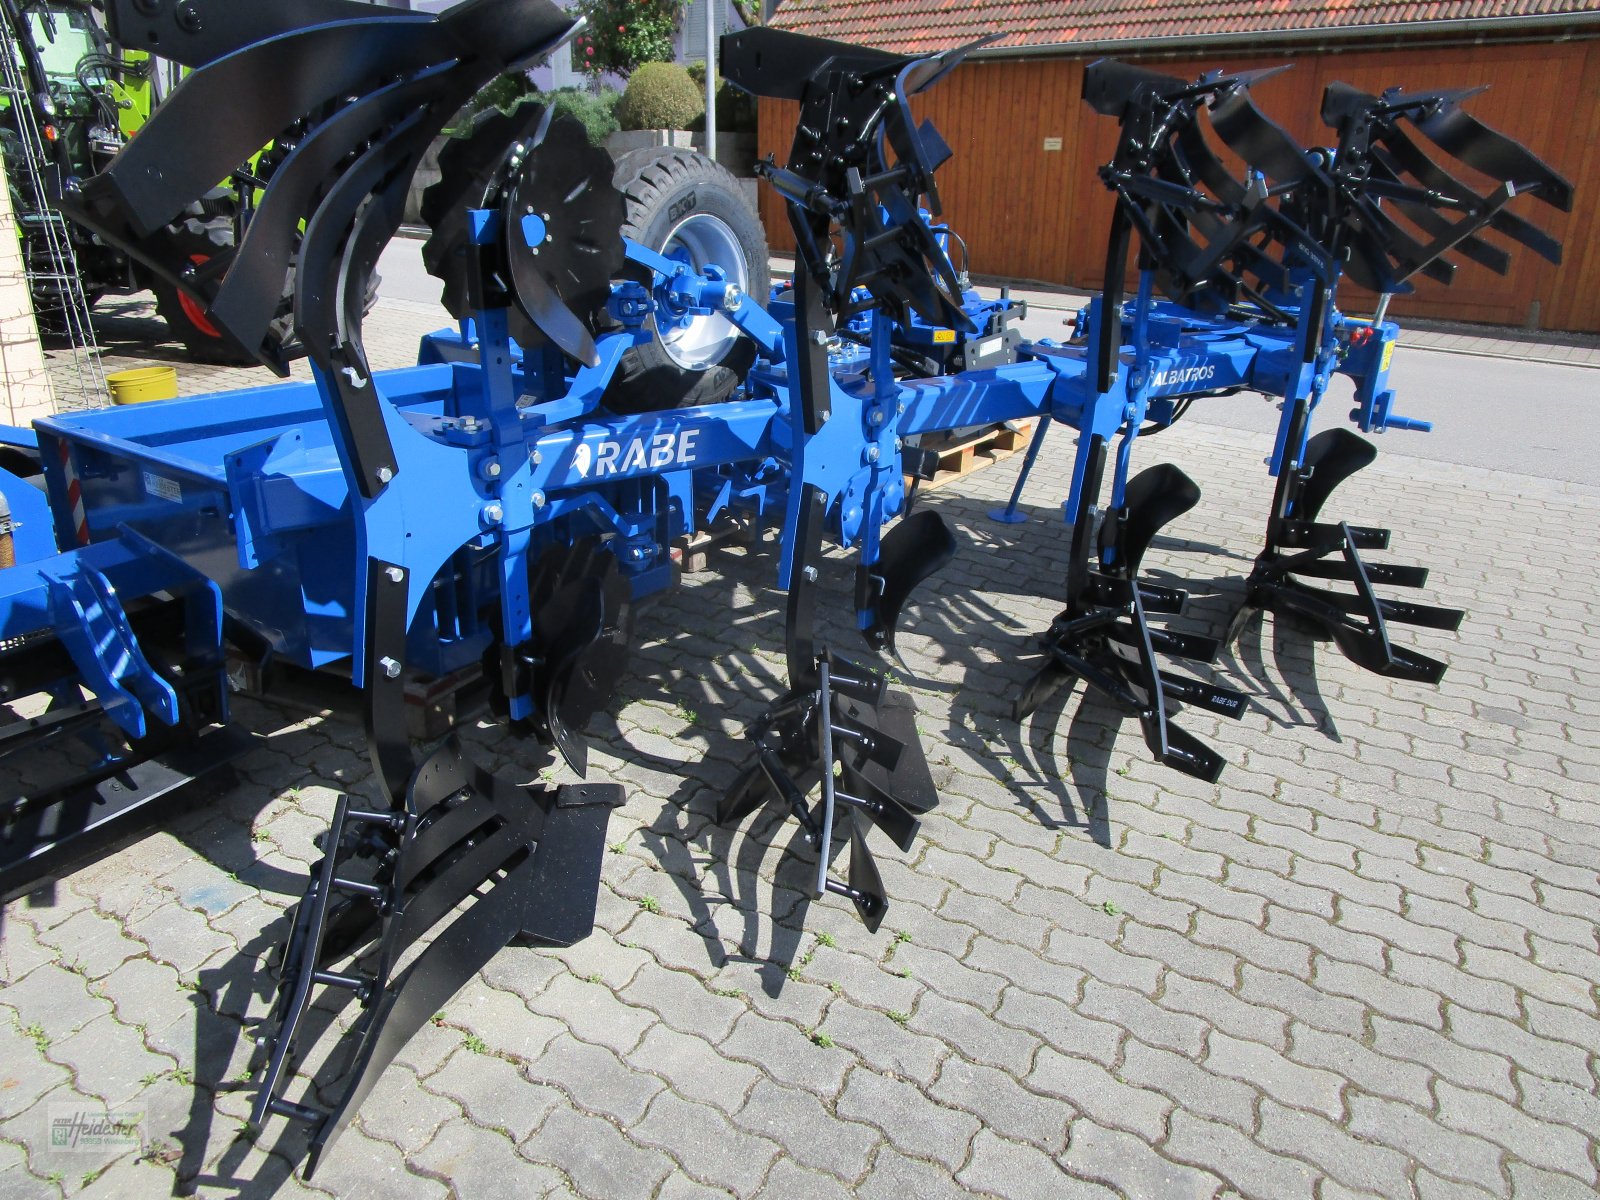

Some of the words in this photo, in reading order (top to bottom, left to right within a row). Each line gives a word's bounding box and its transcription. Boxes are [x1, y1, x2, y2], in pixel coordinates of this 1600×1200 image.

[1151, 365, 1215, 387] ALBATROS
[596, 429, 700, 476] RABE
[1211, 695, 1228, 705] RABE
[1225, 699, 1239, 708] DUR
